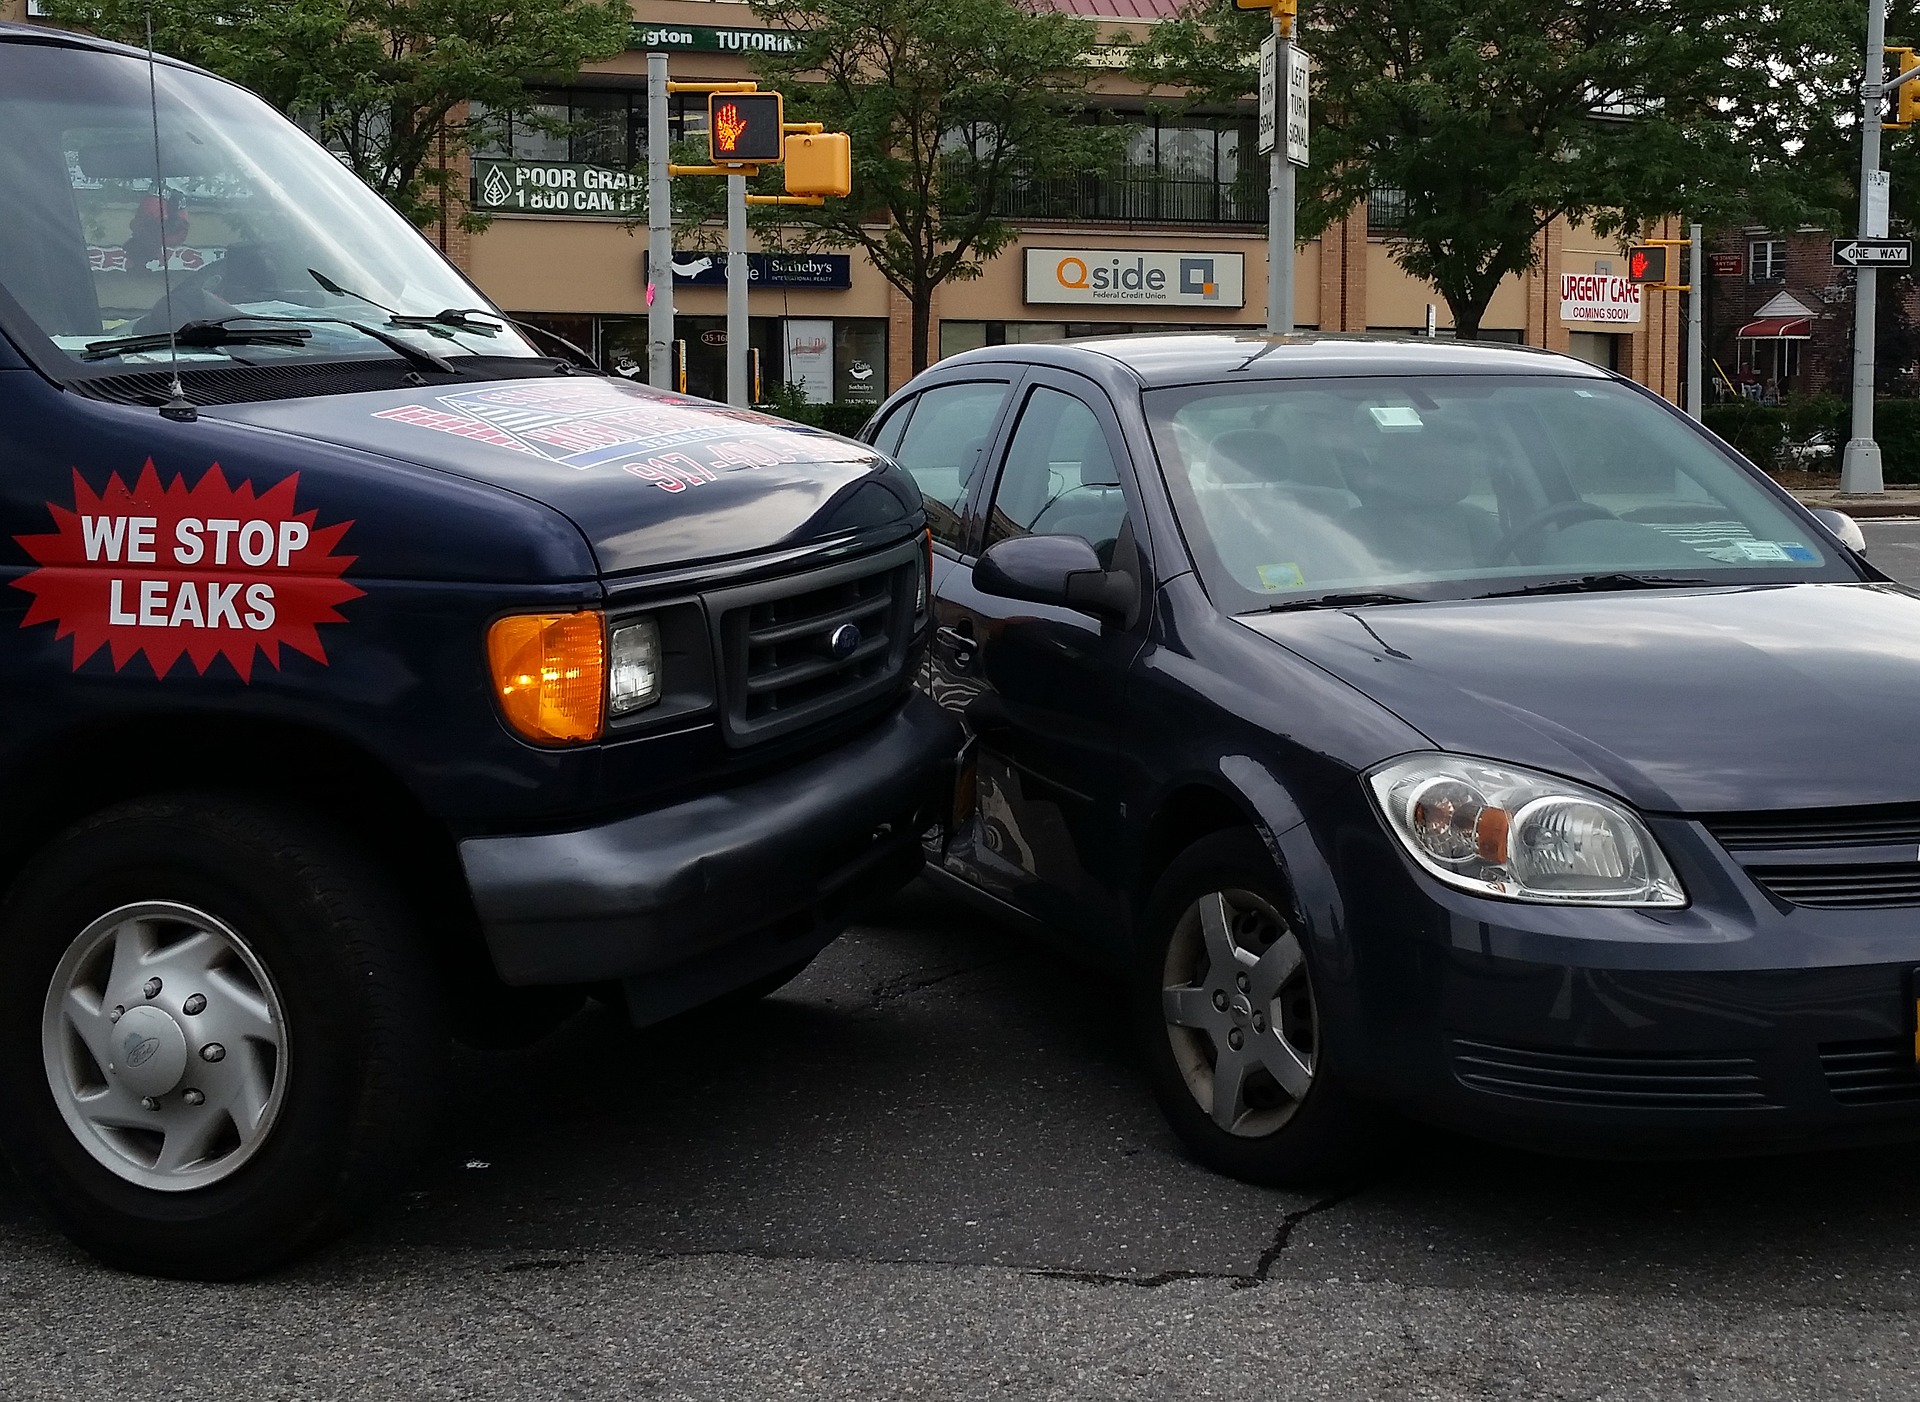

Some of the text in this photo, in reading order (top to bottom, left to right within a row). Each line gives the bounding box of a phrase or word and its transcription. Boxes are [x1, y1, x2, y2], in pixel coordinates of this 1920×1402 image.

[1262, 52, 1274, 77] LEFT
[1291, 64, 1306, 89] LEFT
[1291, 93, 1306, 119] TURN
[1289, 122, 1308, 148] SIGNAL
[516, 167, 649, 191] POOR GRAD
[516, 189, 525, 207] 1
[531, 191, 569, 209] 800
[574, 192, 615, 211] CAN
[1848, 248, 1903, 259] ONE WAY
[1056, 257, 1166, 290] Qside
[1093, 291, 1120, 299] Federal
[1145, 292, 1167, 300] Union
[1562, 275, 1640, 303] URGENT CARE
[1573, 307, 1629, 319] COMING SOON
[81, 515, 309, 567] WE STOP
[109, 579, 276, 630] LEAKS
